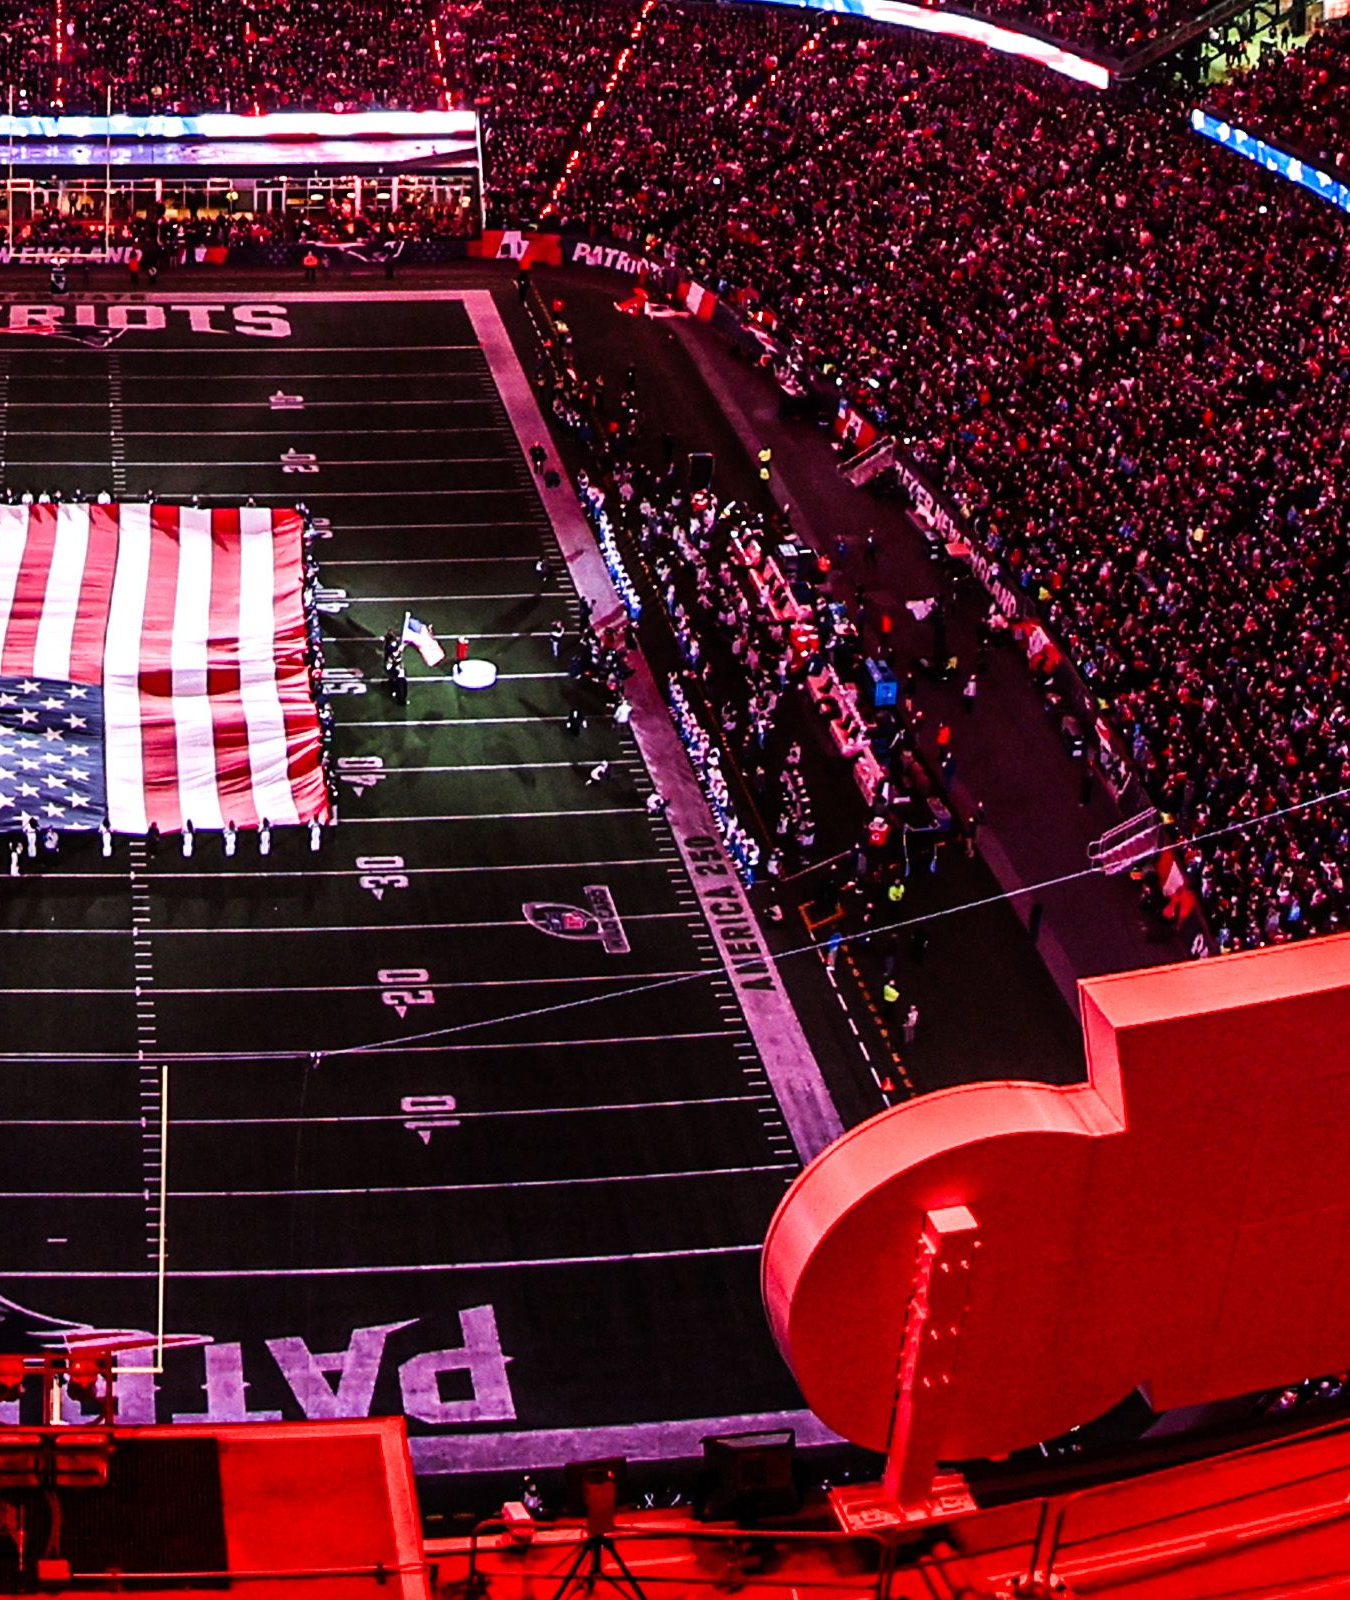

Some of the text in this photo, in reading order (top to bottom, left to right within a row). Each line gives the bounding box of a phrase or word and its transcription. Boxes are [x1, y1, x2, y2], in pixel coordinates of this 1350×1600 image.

[18, 246, 143, 264] ENGLAND
[356, 856, 409, 889] 30
[684, 836, 778, 991] AMERICA 250
[378, 969, 435, 1005] 20
[401, 1095, 461, 1131] 10
